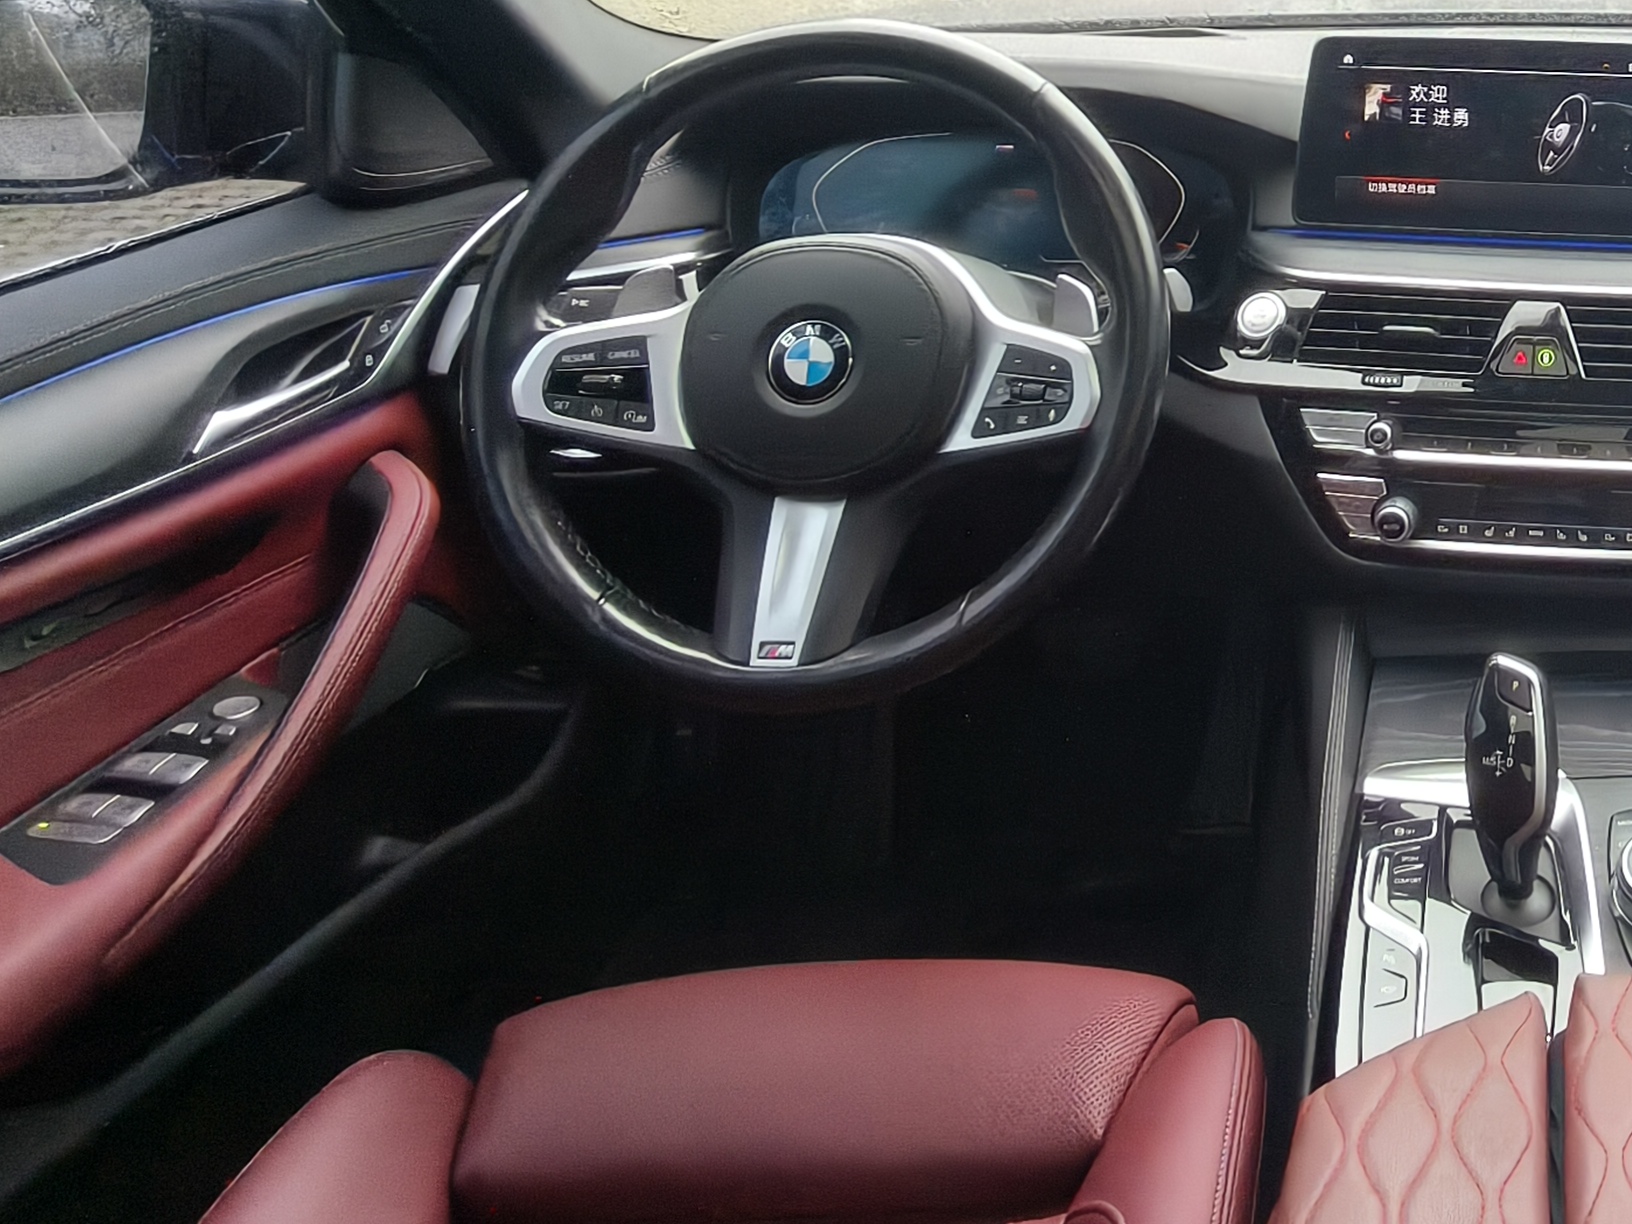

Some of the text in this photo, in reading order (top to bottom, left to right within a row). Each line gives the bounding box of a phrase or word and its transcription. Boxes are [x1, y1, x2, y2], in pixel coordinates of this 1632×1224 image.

[1408, 83, 1448, 103] 欢迎
[1408, 107, 1469, 127] 王 进勇
[780, 325, 845, 349] BMW
[1511, 680, 1519, 692] P
[1506, 757, 1514, 768] D
[1393, 877, 1422, 885] COMFORT
